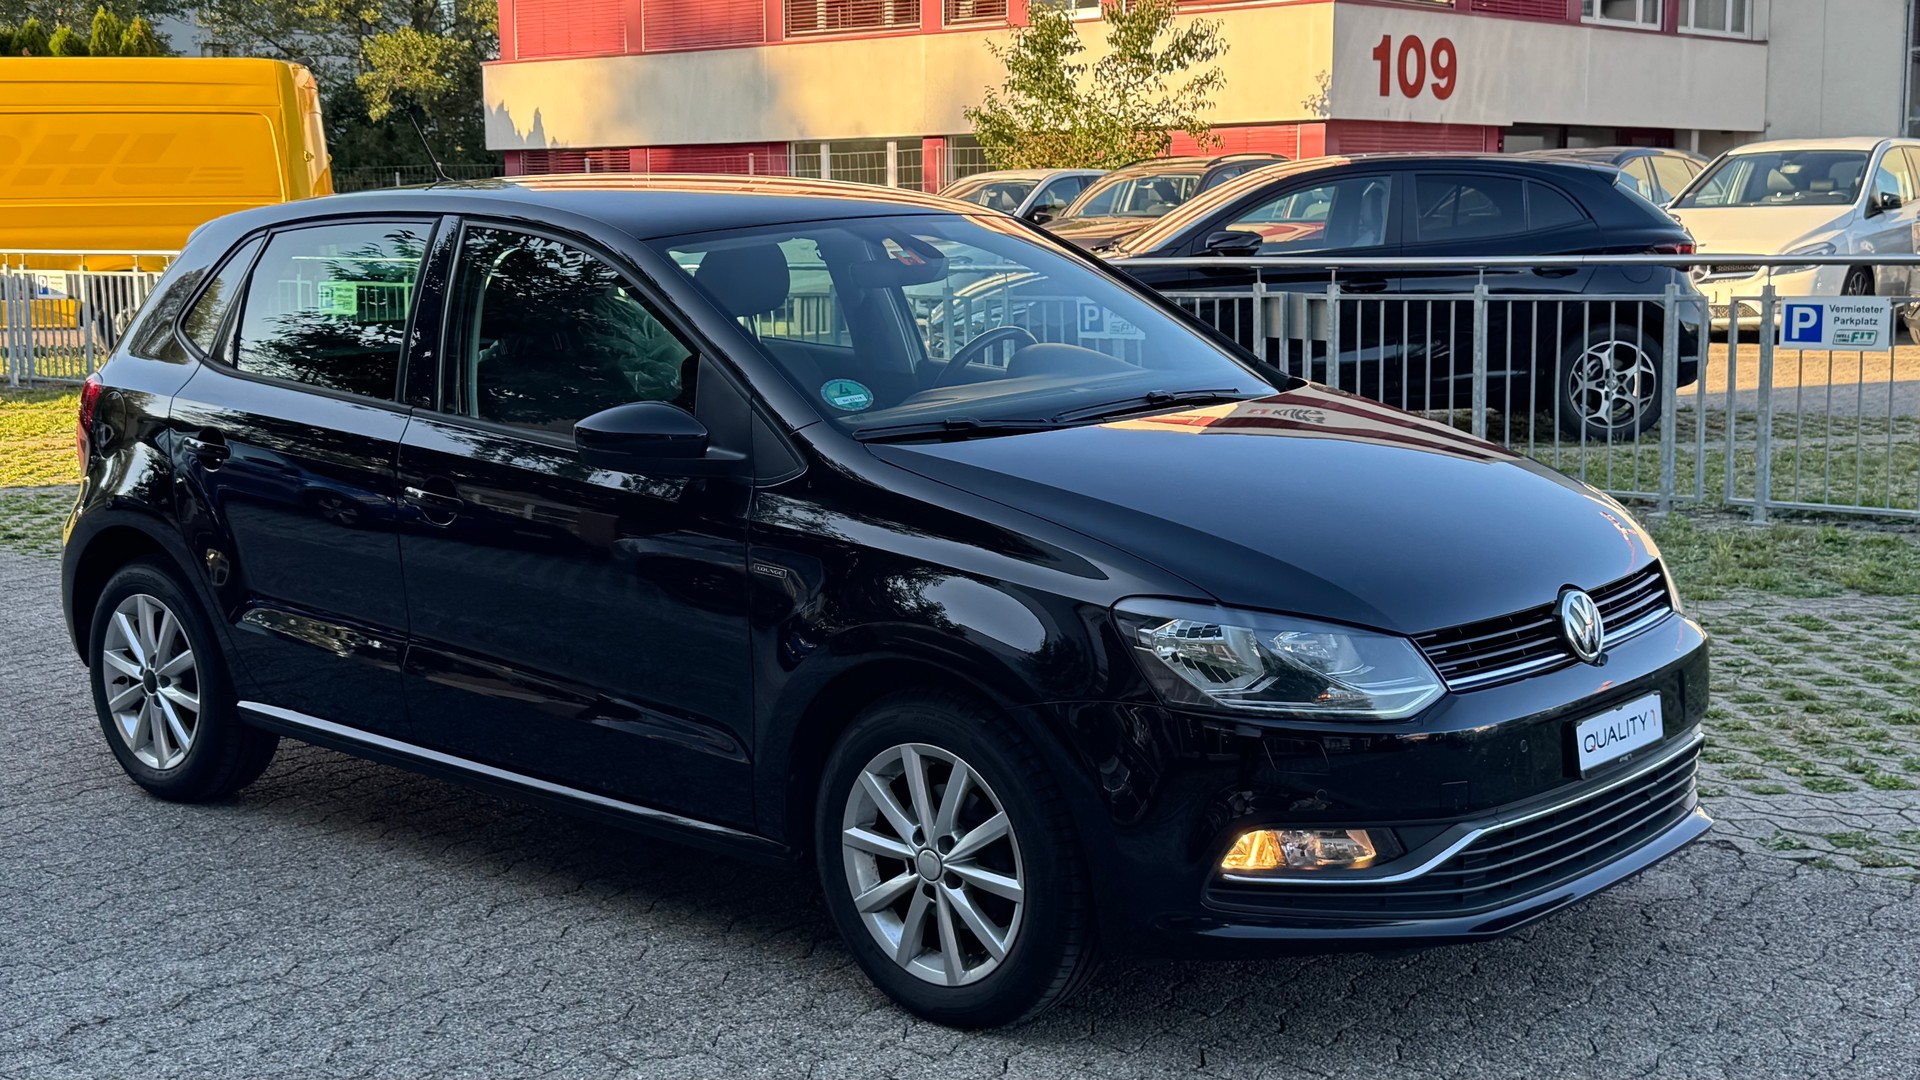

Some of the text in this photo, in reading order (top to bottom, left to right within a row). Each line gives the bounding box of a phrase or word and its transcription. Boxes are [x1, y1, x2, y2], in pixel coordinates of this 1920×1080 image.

[1372, 34, 1457, 101] 109
[0, 133, 195, 187] HL
[1829, 304, 1884, 314] Vermieteter
[1084, 305, 1100, 330] P
[1791, 306, 1818, 340] P
[1833, 316, 1878, 327] Parkplatz
[1850, 331, 1875, 343] FIT
[839, 383, 852, 396] 4
[757, 566, 784, 576] LOUNGE
